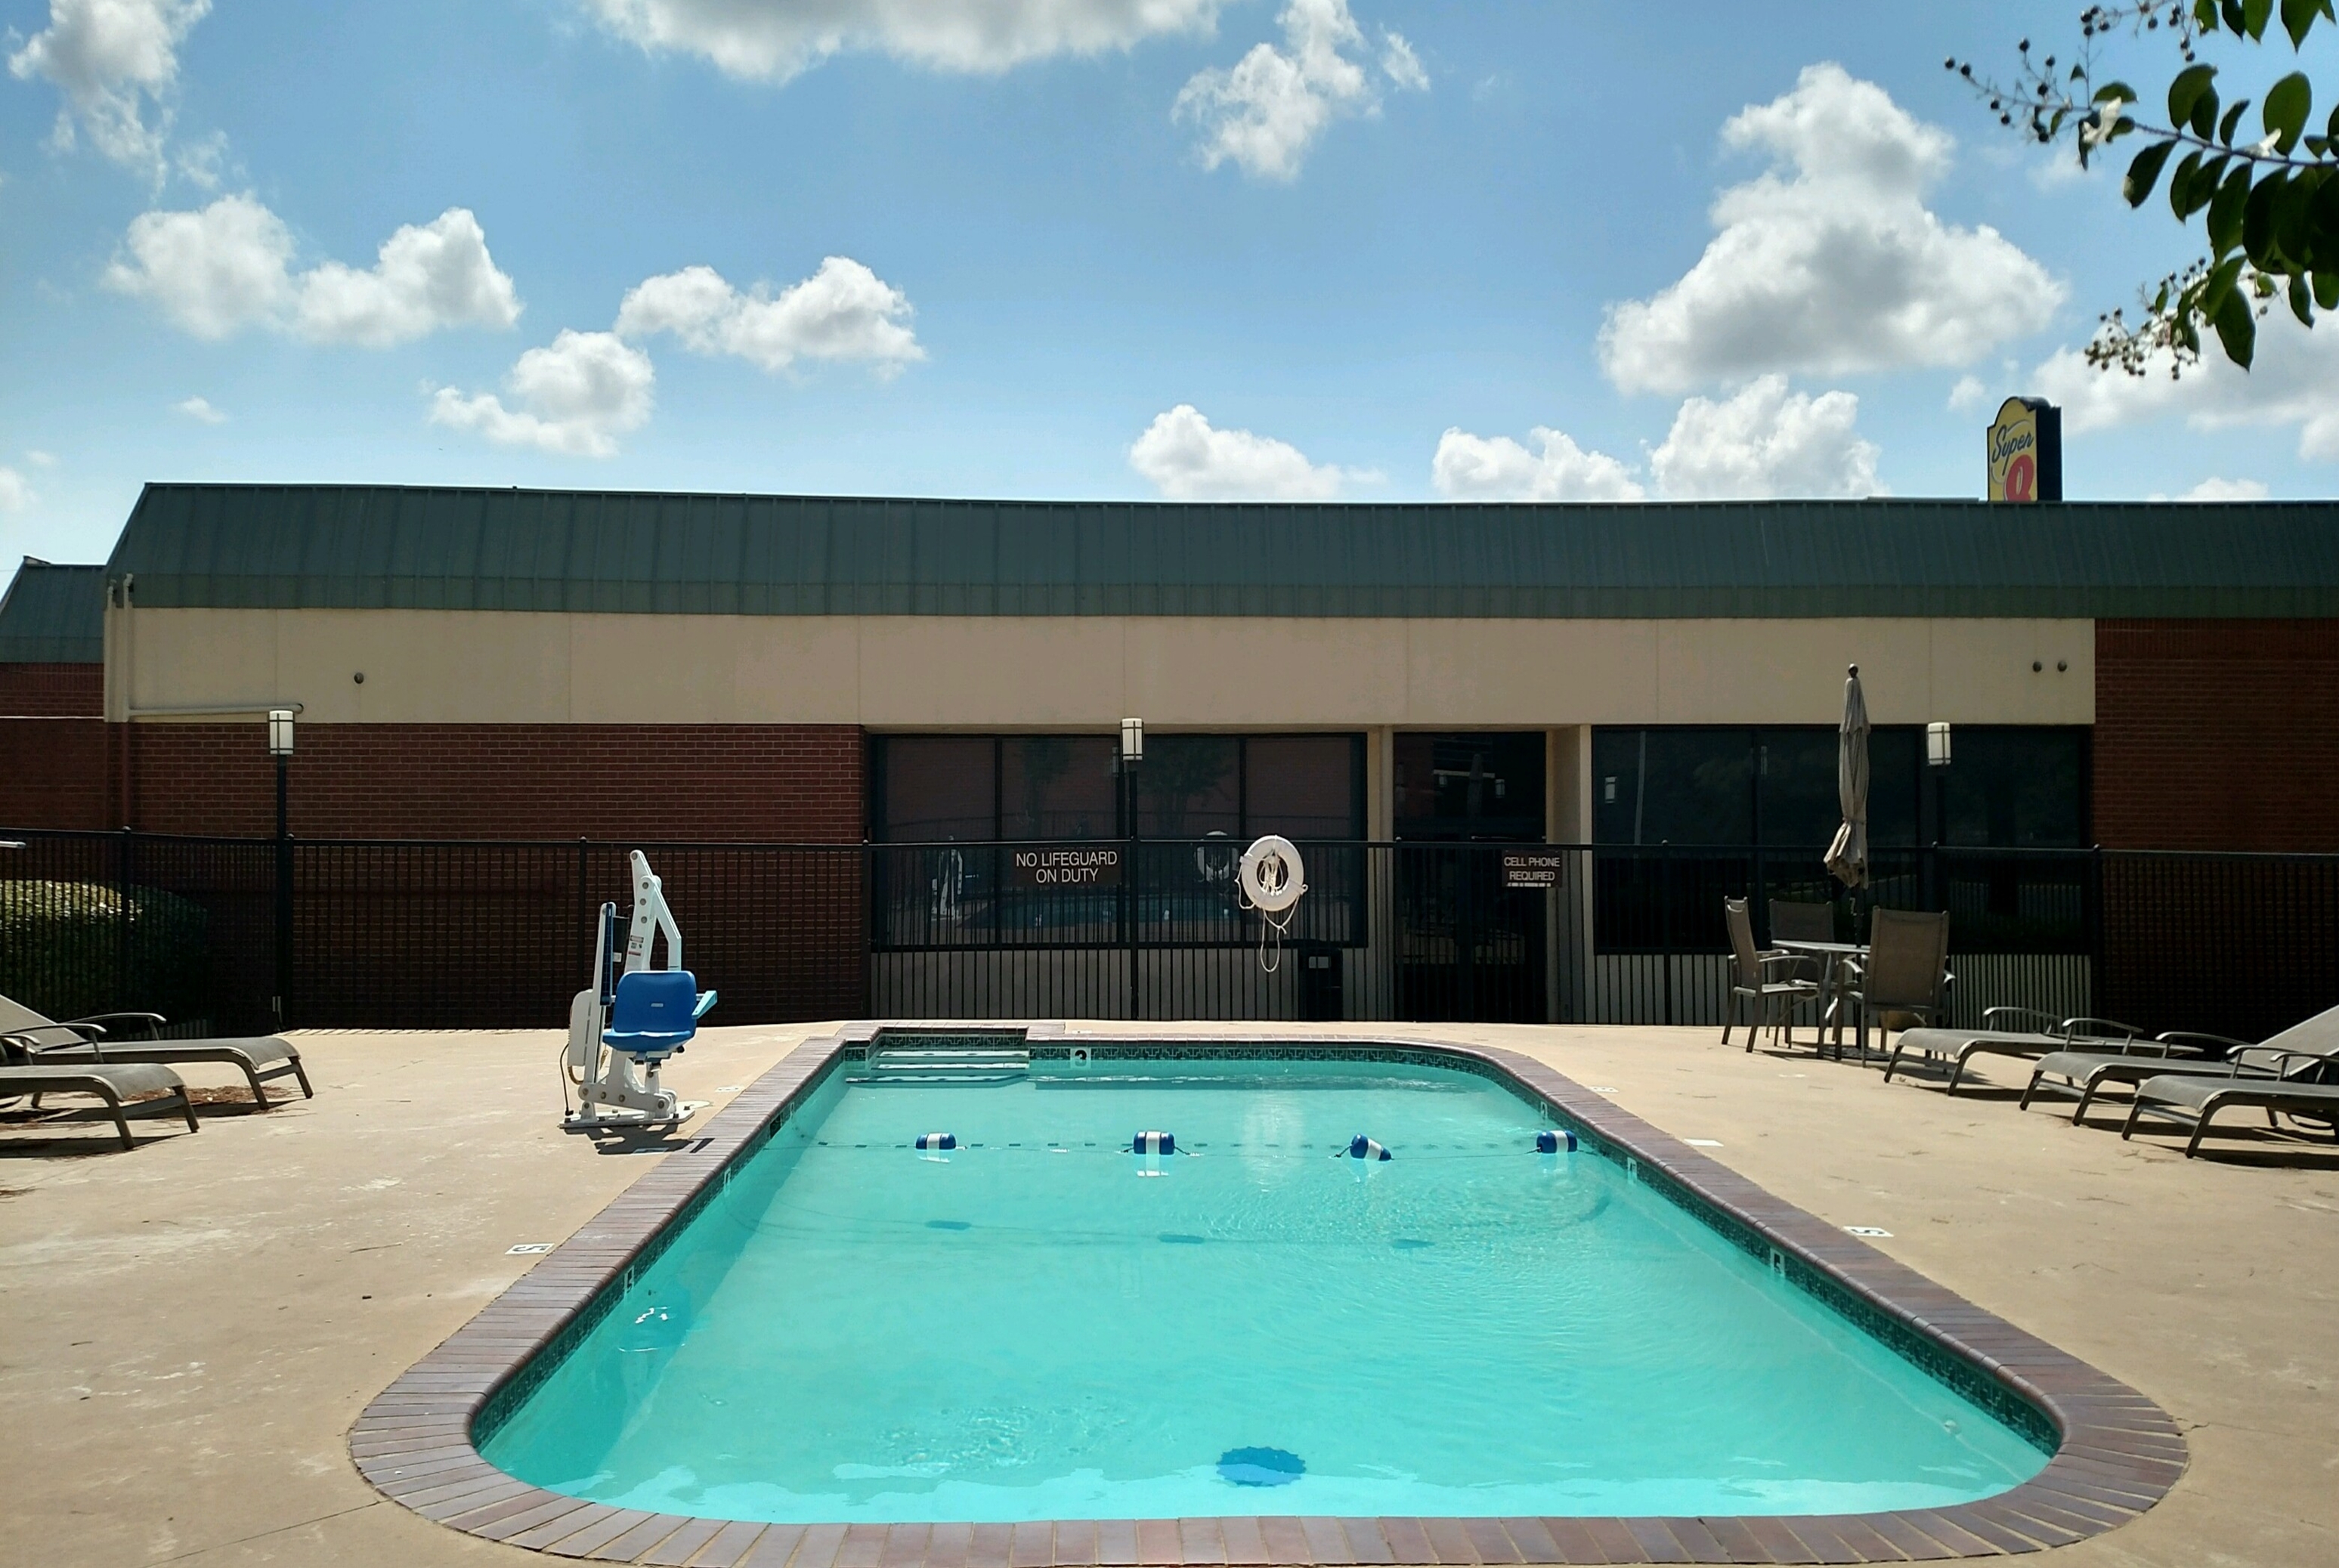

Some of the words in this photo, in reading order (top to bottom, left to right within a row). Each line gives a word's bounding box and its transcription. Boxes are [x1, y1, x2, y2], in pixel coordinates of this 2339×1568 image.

[1991, 423, 2034, 477] Super
[1016, 852, 1038, 867] NO
[1041, 851, 1118, 867] LIFEGUARD
[1504, 857, 1527, 867] CELL
[1528, 857, 1561, 867] PHONE
[1035, 868, 1057, 883] ON
[1061, 868, 1099, 883] DUTY
[1509, 871, 1555, 881] REQUIRED
[1075, 1049, 1088, 1066] 3
